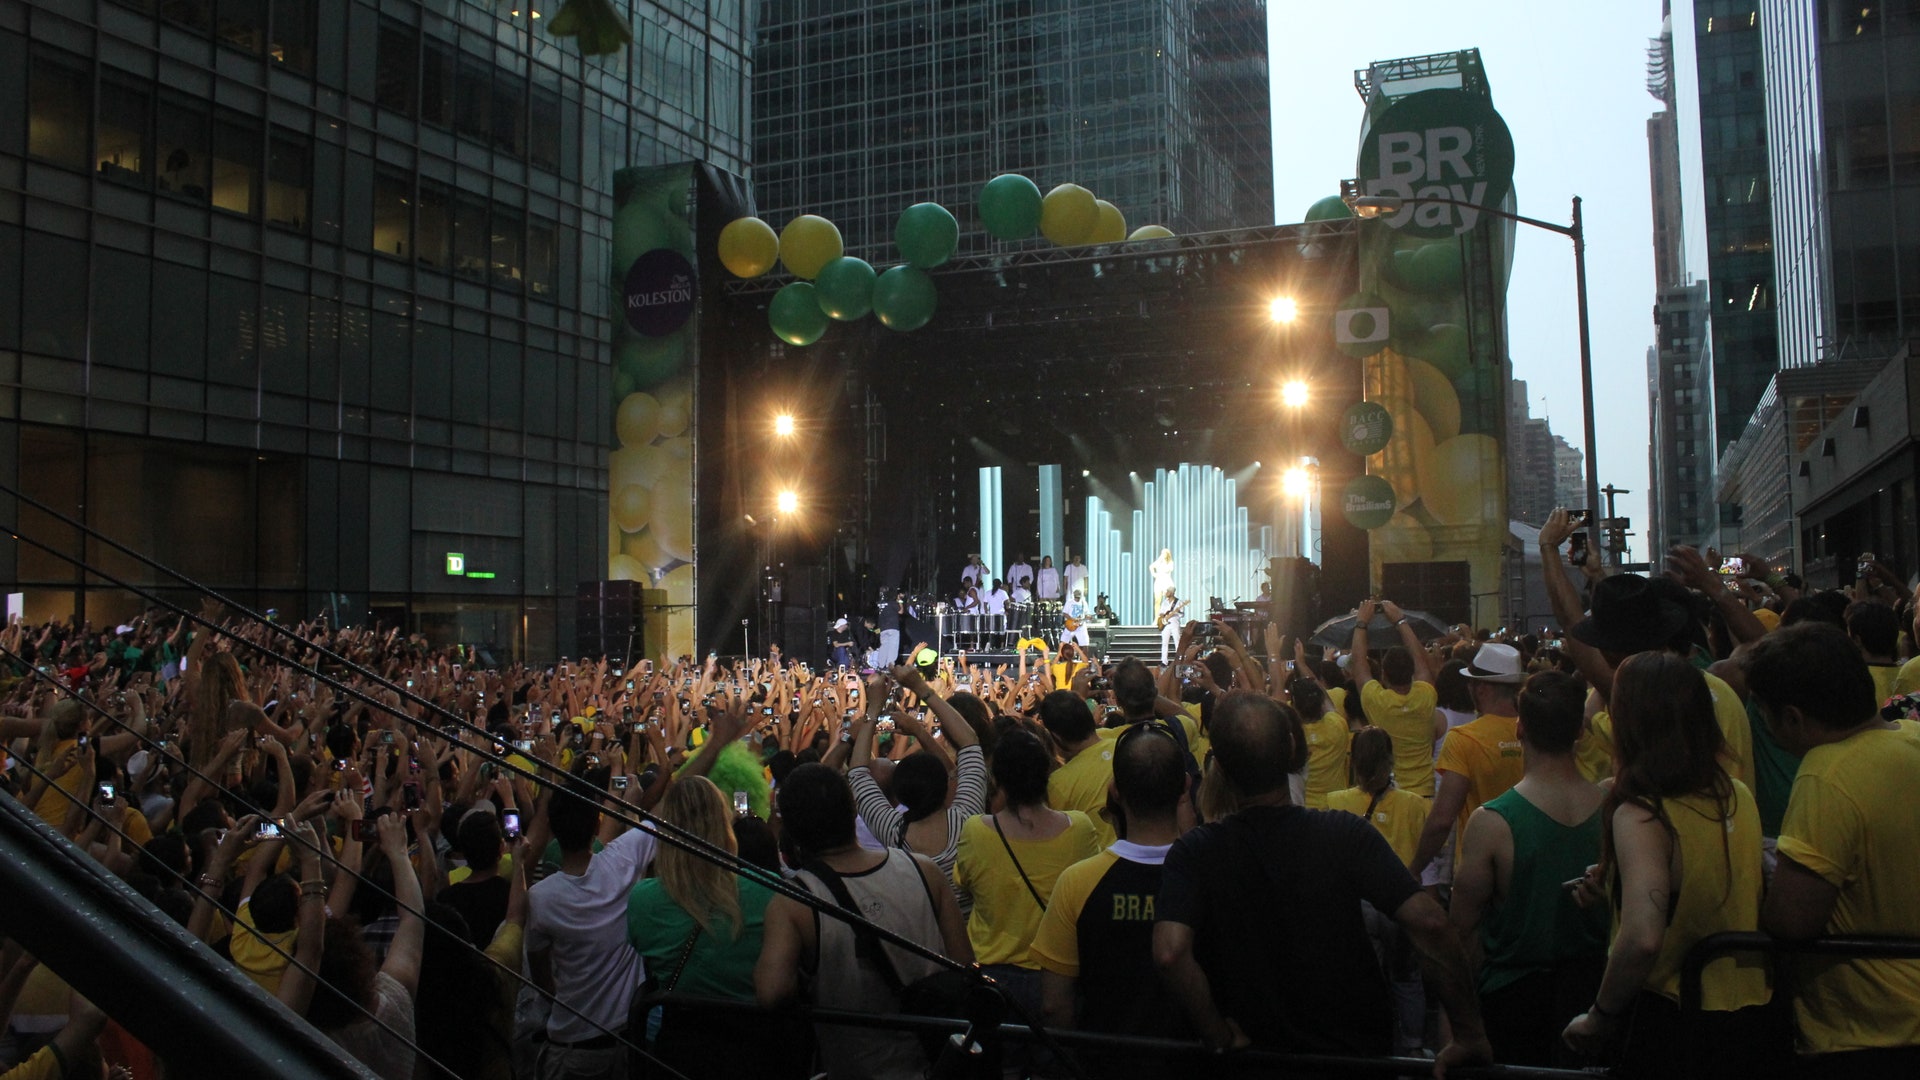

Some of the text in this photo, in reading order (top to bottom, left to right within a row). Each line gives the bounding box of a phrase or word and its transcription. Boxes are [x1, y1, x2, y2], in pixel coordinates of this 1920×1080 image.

[1378, 126, 1474, 185] BR
[1474, 123, 1486, 177] NEW YORK
[1366, 177, 1488, 235] Day
[628, 287, 691, 308] KOLESTON
[1348, 494, 1366, 503] The
[448, 556, 463, 571] TD
